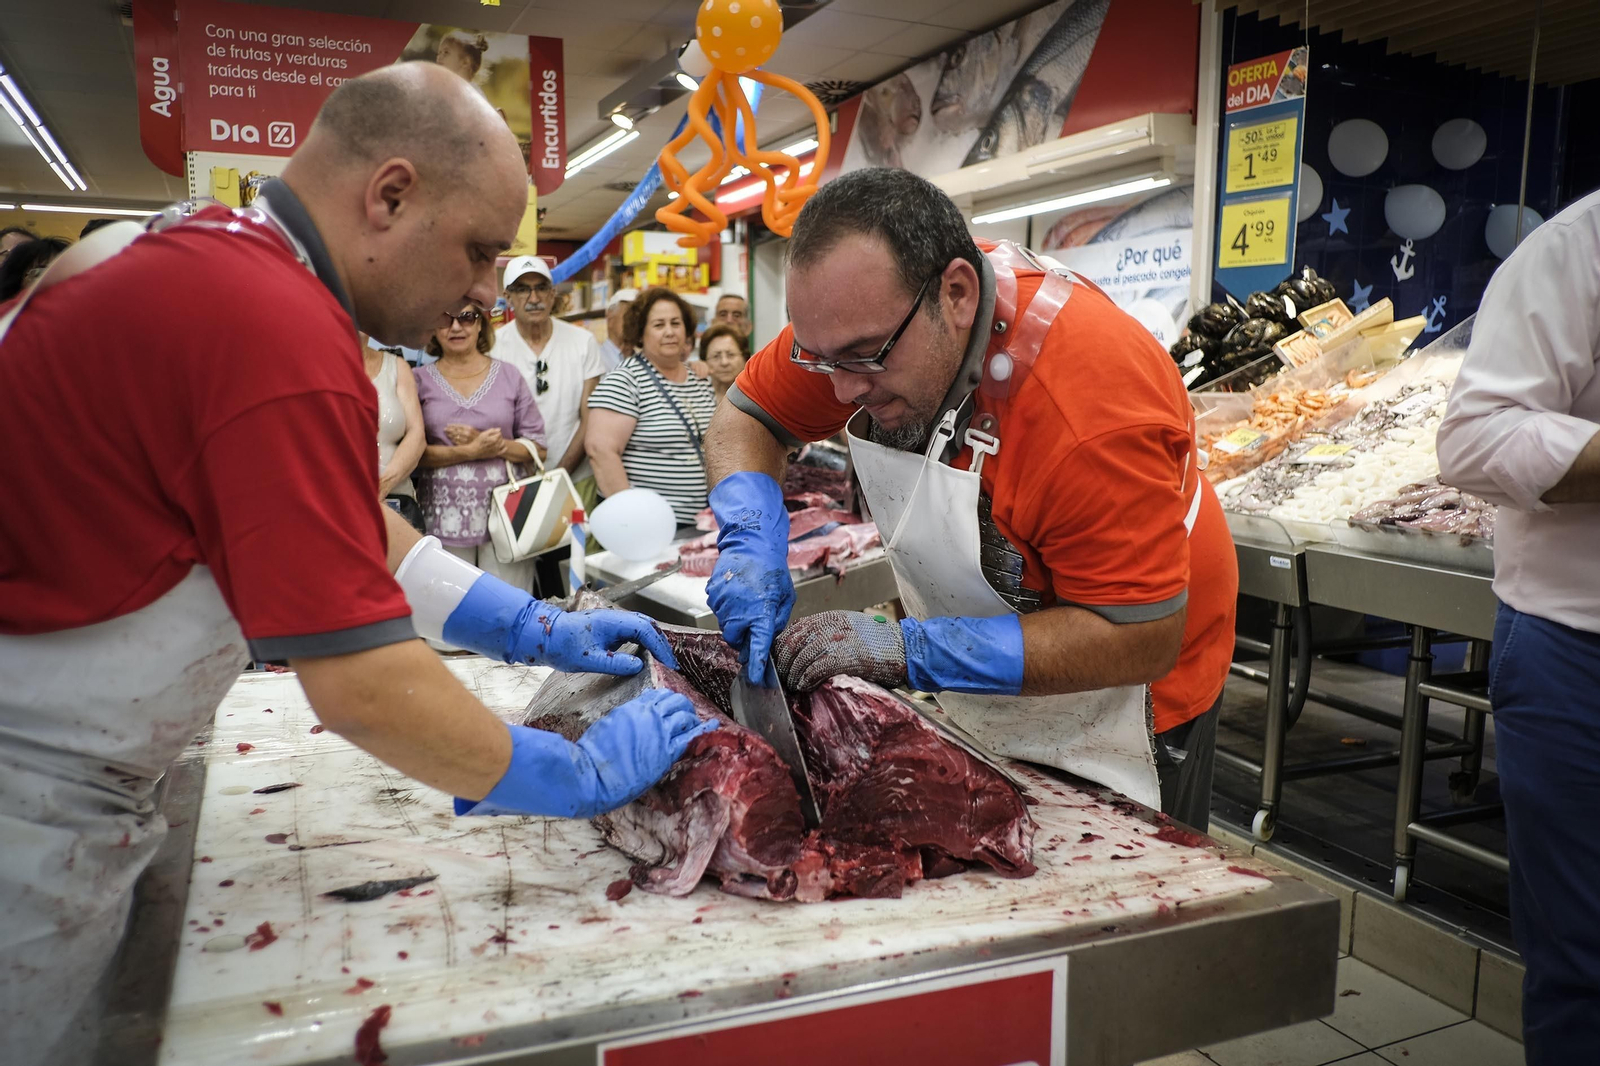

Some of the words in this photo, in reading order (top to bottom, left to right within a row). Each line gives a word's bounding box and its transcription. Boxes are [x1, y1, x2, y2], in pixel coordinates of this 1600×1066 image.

[205, 24, 235, 39] Con
[239, 30, 268, 43] una
[271, 33, 305, 47] gran
[308, 35, 372, 53] selección
[206, 43, 226, 57] de
[229, 44, 271, 62] frutas
[274, 53, 283, 66] y
[286, 53, 347, 69] verduras
[207, 63, 258, 79] traídas
[262, 67, 306, 84] desde
[310, 72, 322, 86] el
[1228, 60, 1278, 87] OFERTA
[150, 57, 177, 118] Agua
[209, 83, 244, 98] para
[247, 85, 256, 98] ti
[1227, 91, 1244, 108] del
[1246, 83, 1271, 104] DIA
[210, 118, 260, 144] Dia
[538, 69, 560, 168] Encurtidos
[1116, 247, 1148, 271] ¿Por
[1152, 239, 1182, 266] qué
[1113, 274, 1120, 284] el
[1122, 270, 1157, 286] pescado
